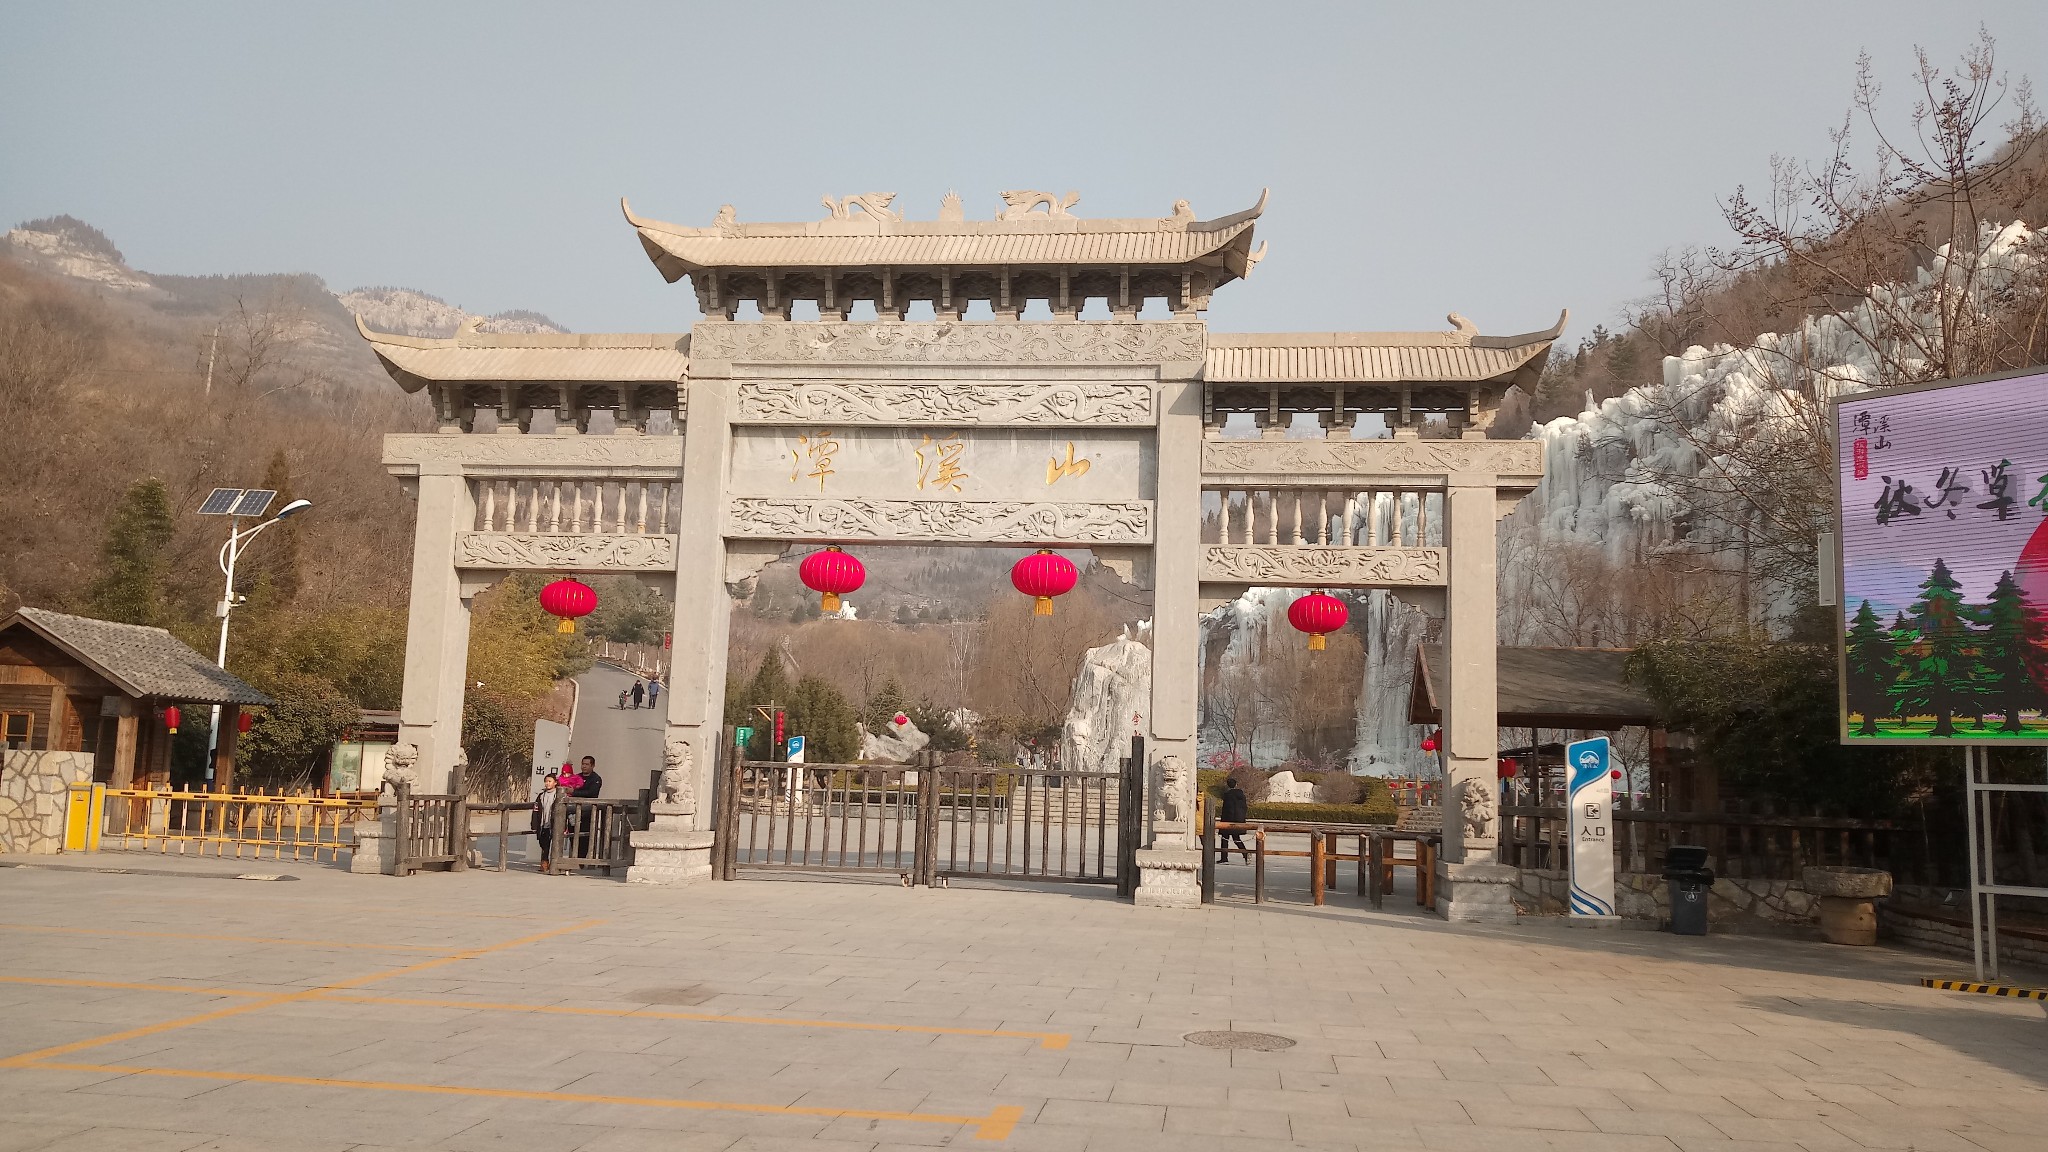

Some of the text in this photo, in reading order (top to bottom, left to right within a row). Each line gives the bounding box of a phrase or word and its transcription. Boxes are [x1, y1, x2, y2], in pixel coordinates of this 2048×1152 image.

[789, 431, 1091, 493] 潭溪山
[536, 765, 559, 776] 出口
[1581, 825, 1606, 837] 入口
